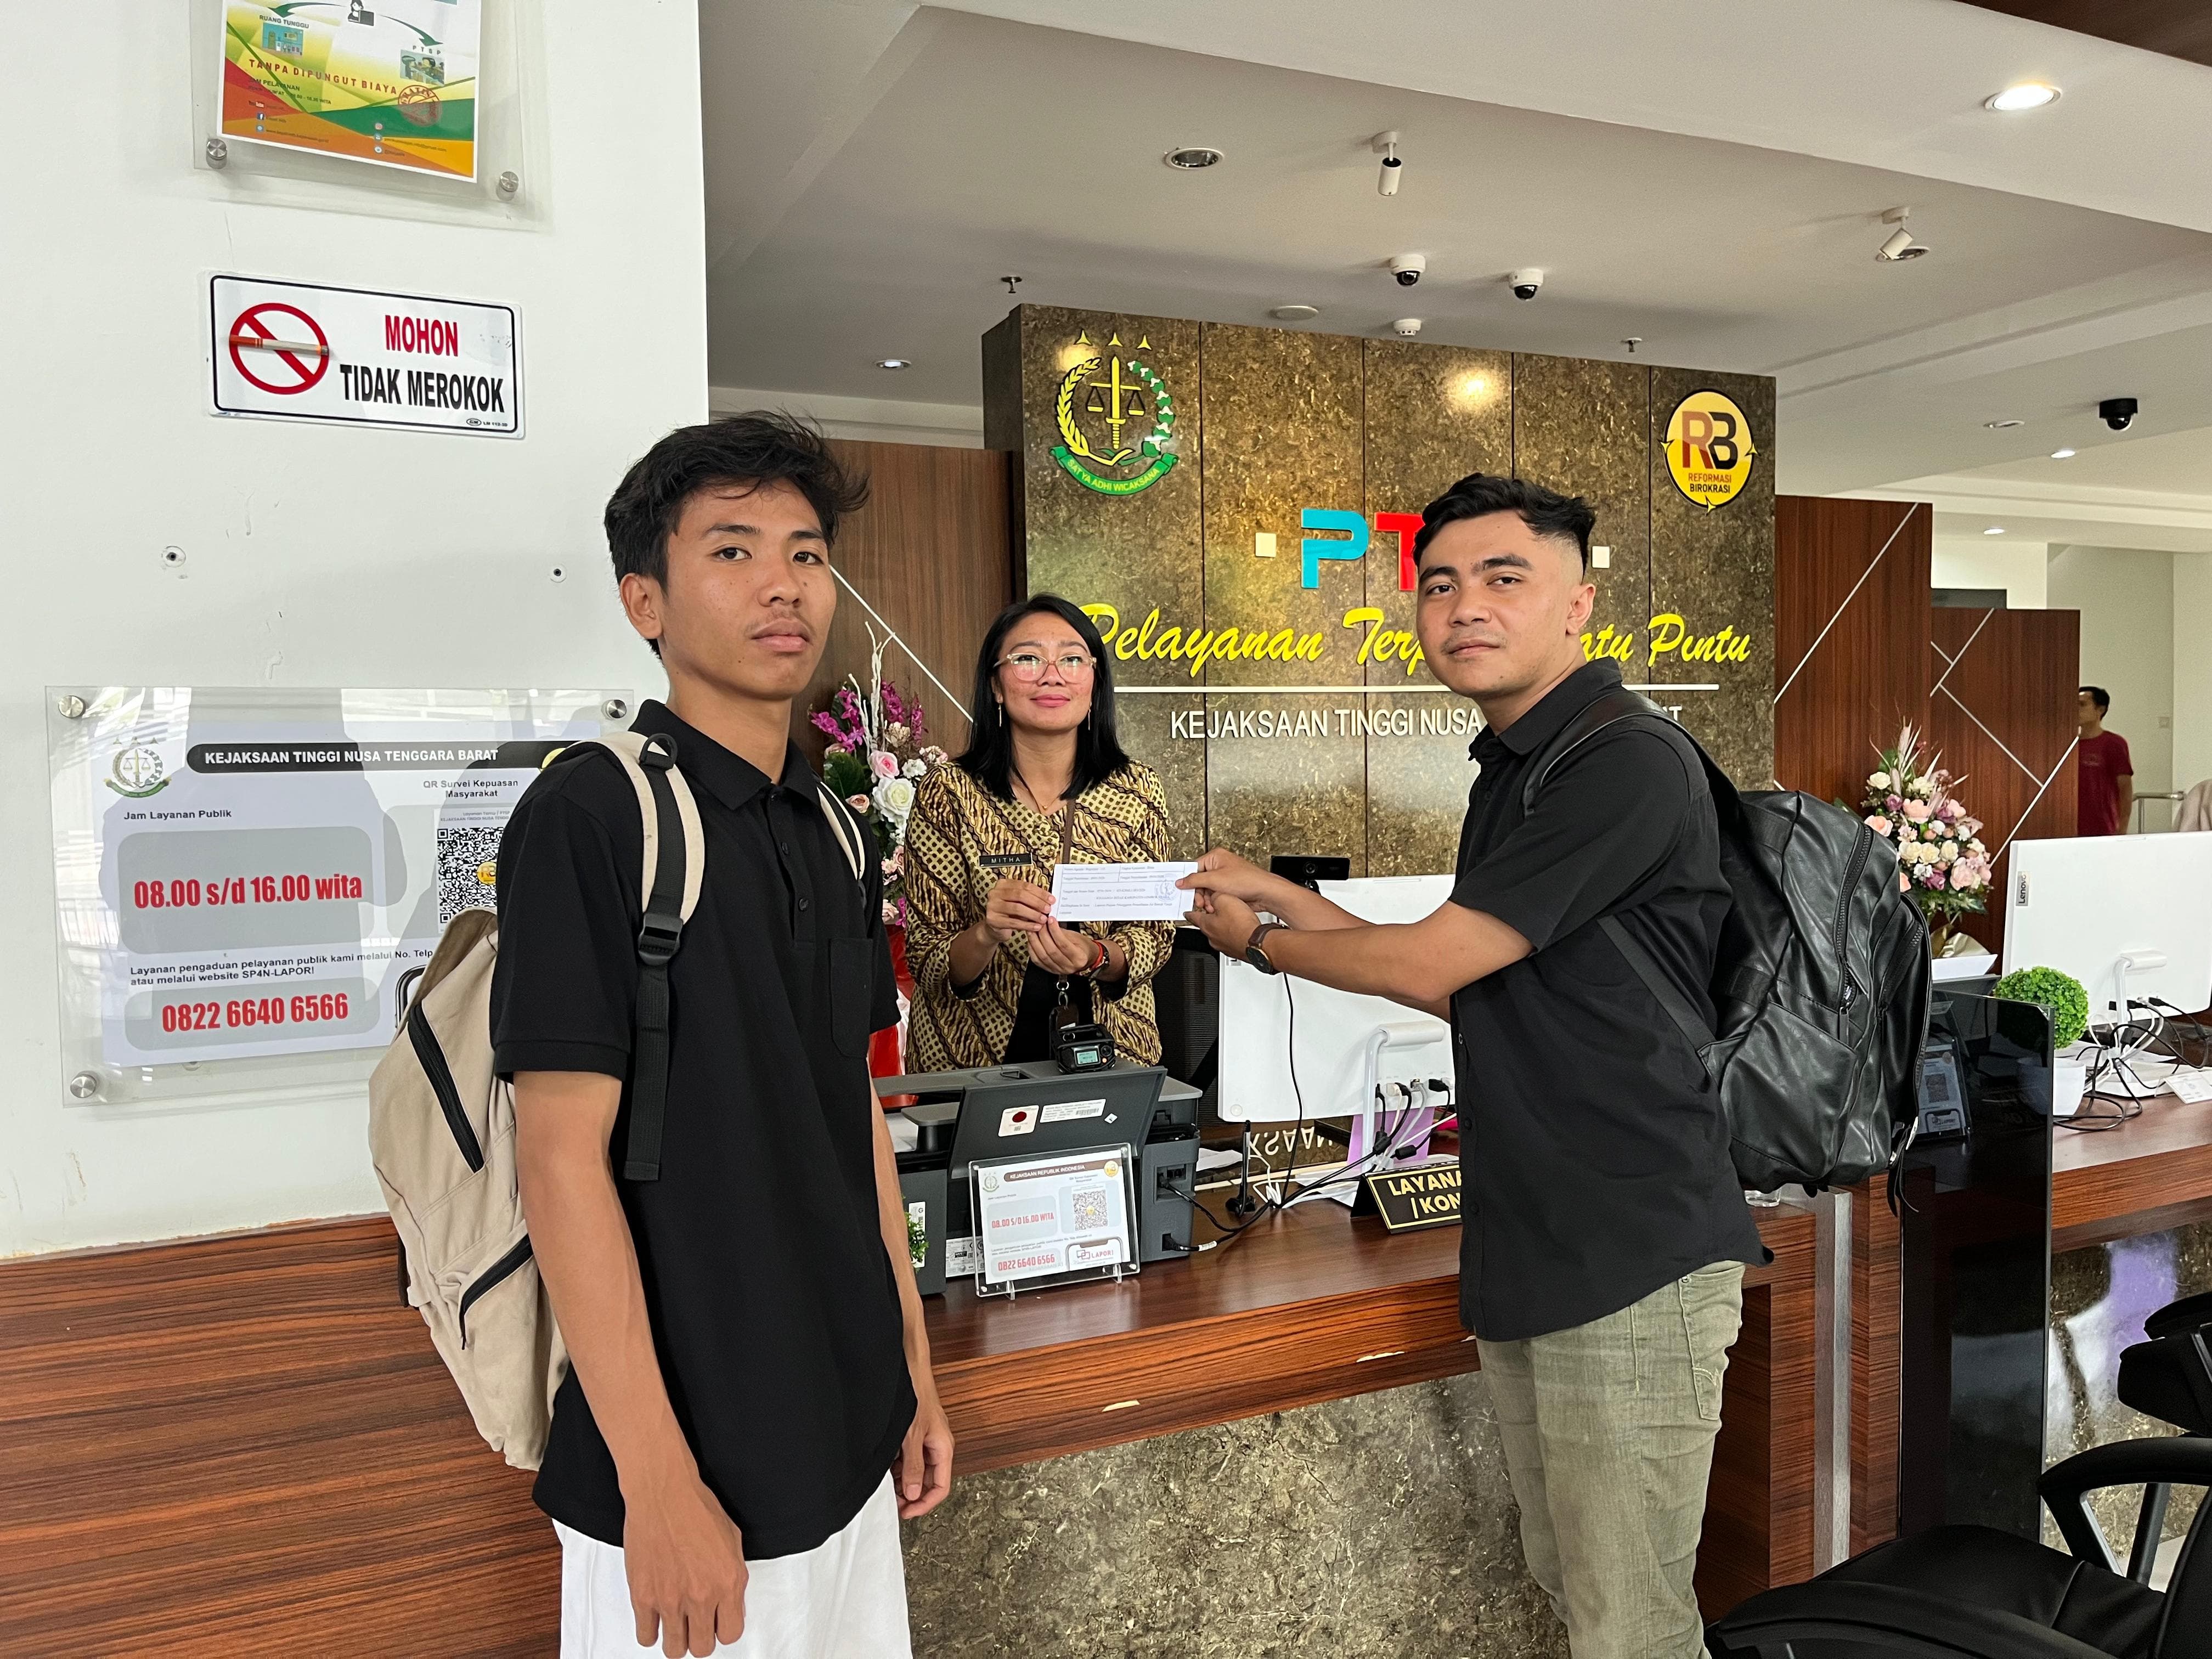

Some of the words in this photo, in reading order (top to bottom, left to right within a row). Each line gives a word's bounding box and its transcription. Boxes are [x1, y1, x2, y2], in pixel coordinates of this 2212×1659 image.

[259, 15, 281, 24] RUANG
[283, 19, 309, 29] TUNGGU
[249, 59, 288, 74] TANPA
[294, 67, 357, 87] DIPUNGUT
[362, 81, 396, 94] BIAYA
[385, 315, 459, 357] MOHON
[340, 364, 403, 405] TIDAK
[408, 370, 505, 413] MEROKOK
[1682, 411, 1738, 470] RB
[1091, 479, 1111, 491] ADHI
[1113, 468, 1159, 491] WICAKSANA
[1688, 472, 1732, 483] REFORMASI
[1690, 483, 1730, 493] BIROKRASI
[1301, 508, 1425, 591] PT
[1079, 603, 1324, 678] Pelayanan
[1342, 607, 1426, 676] Terp
[1647, 613, 1751, 668] Pintu
[1170, 710, 1328, 739] KEJAKSAAN
[1333, 709, 1414, 736] TINGGI
[1420, 708, 1482, 736] NUSA
[205, 752, 289, 764] KEJAKSAAN
[293, 751, 340, 763] TINGGI
[345, 751, 381, 762] NUSA
[385, 750, 454, 761] TENGGARA
[458, 749, 498, 761] BARAT
[423, 781, 438, 789] QR
[441, 780, 470, 788] Survei
[473, 780, 518, 788] Kepuasan
[445, 790, 498, 799] Masyarakat
[150, 811, 195, 821] Layanan
[199, 810, 232, 818] Publik
[134, 879, 200, 909] 08.00
[207, 877, 245, 905] s/d
[250, 874, 311, 903] 16.00
[315, 874, 362, 900] wita
[2018, 874, 2027, 904] Lenovo
[131, 966, 176, 976] Layanan
[179, 962, 238, 974] pengaduan
[241, 959, 294, 969] pelayanan
[297, 956, 328, 966] publik
[331, 953, 354, 962] kami
[357, 951, 392, 961] melalui
[157, 974, 195, 984] melalui
[199, 972, 239, 981] website
[162, 1002, 221, 1032] 0822
[227, 997, 285, 1028] 6640
[291, 993, 348, 1023] 6566
[1009, 1171, 1037, 1180] KEJAKSAAN
[1037, 1167, 1060, 1176] REPUBLIK
[1060, 1164, 1085, 1172] INDONESIA
[991, 1218, 1010, 1229] 08.00
[1023, 1214, 1039, 1224] 16.00
[1040, 1212, 1054, 1221] WITA
[998, 1261, 1015, 1271] 0822
[1018, 1257, 1036, 1268] 6640
[1037, 1254, 1055, 1265] 6566
